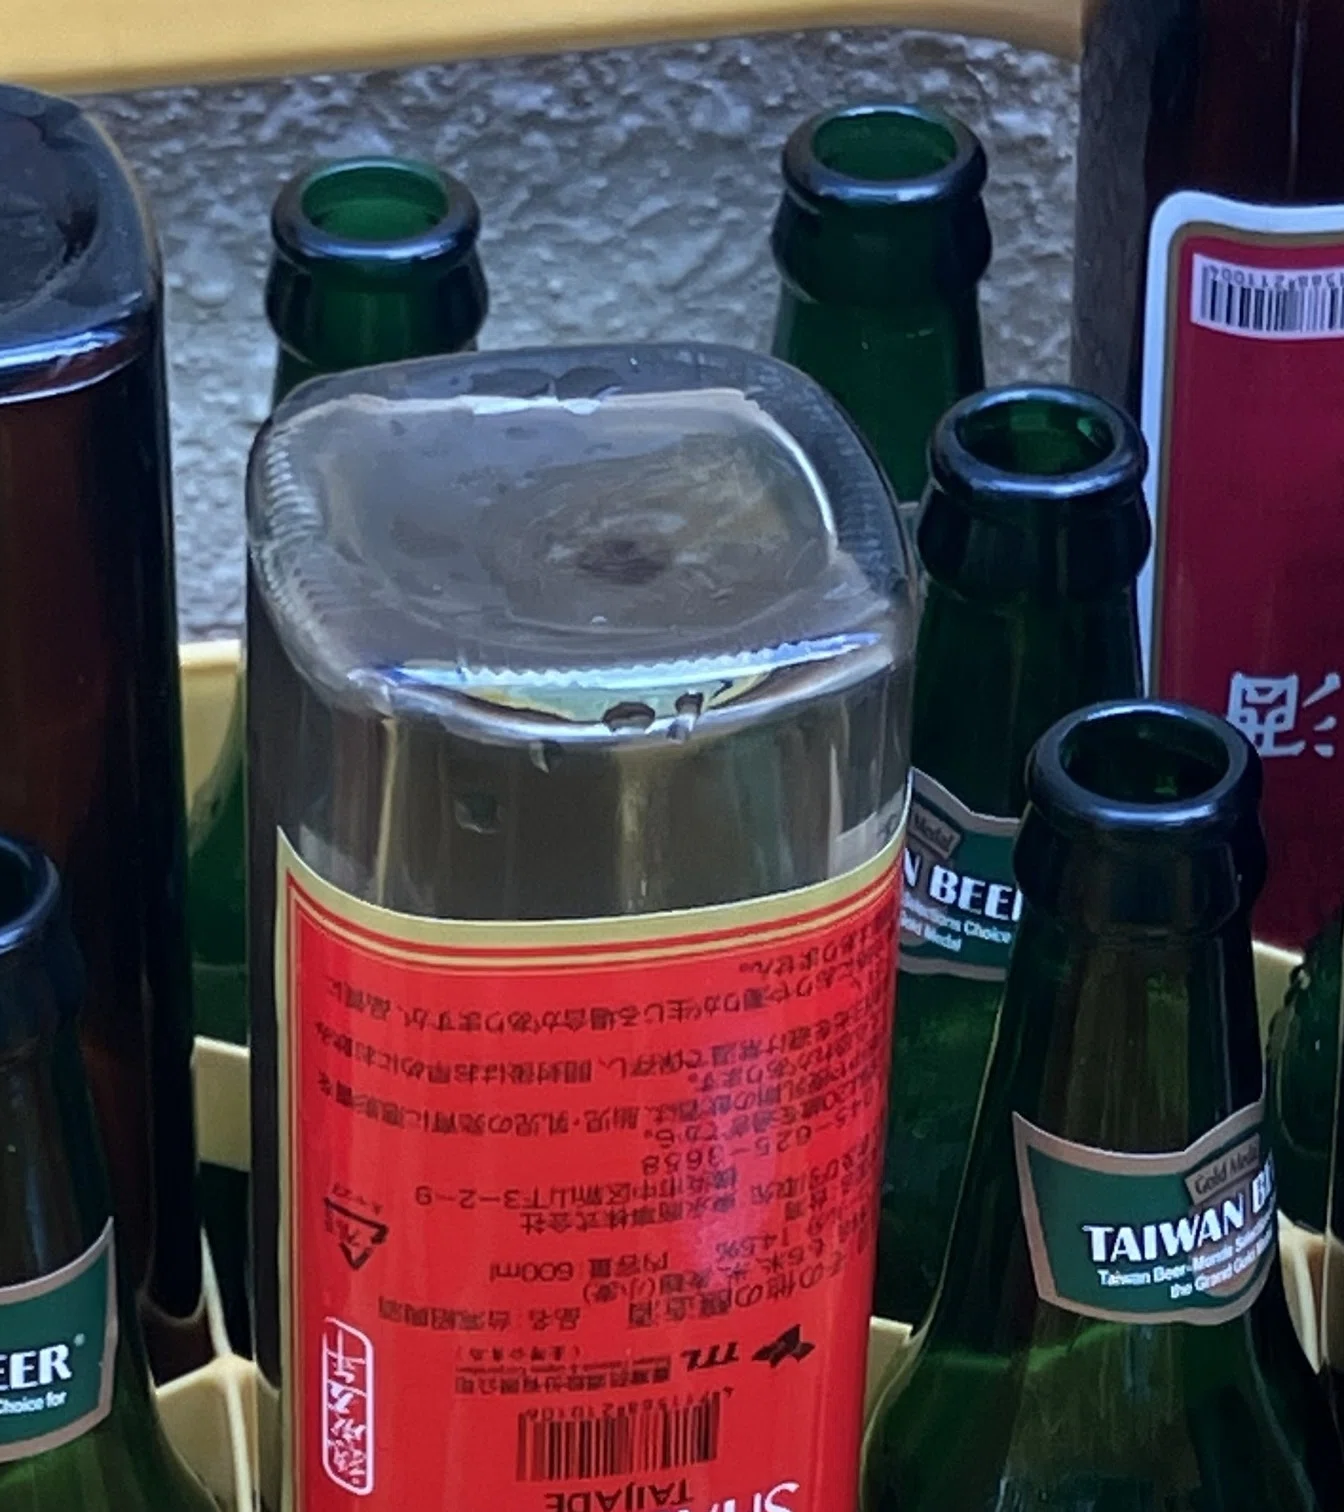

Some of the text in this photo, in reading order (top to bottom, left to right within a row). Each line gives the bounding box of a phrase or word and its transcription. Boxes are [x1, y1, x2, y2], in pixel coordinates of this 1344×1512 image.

[1225, 671, 1342, 758] 酒
[1081, 1192, 1244, 1263] TAIWAN
[489, 1261, 574, 1283] 600ml
[679, 1342, 739, 1372] TTL
[45, 1390, 67, 1408] for
